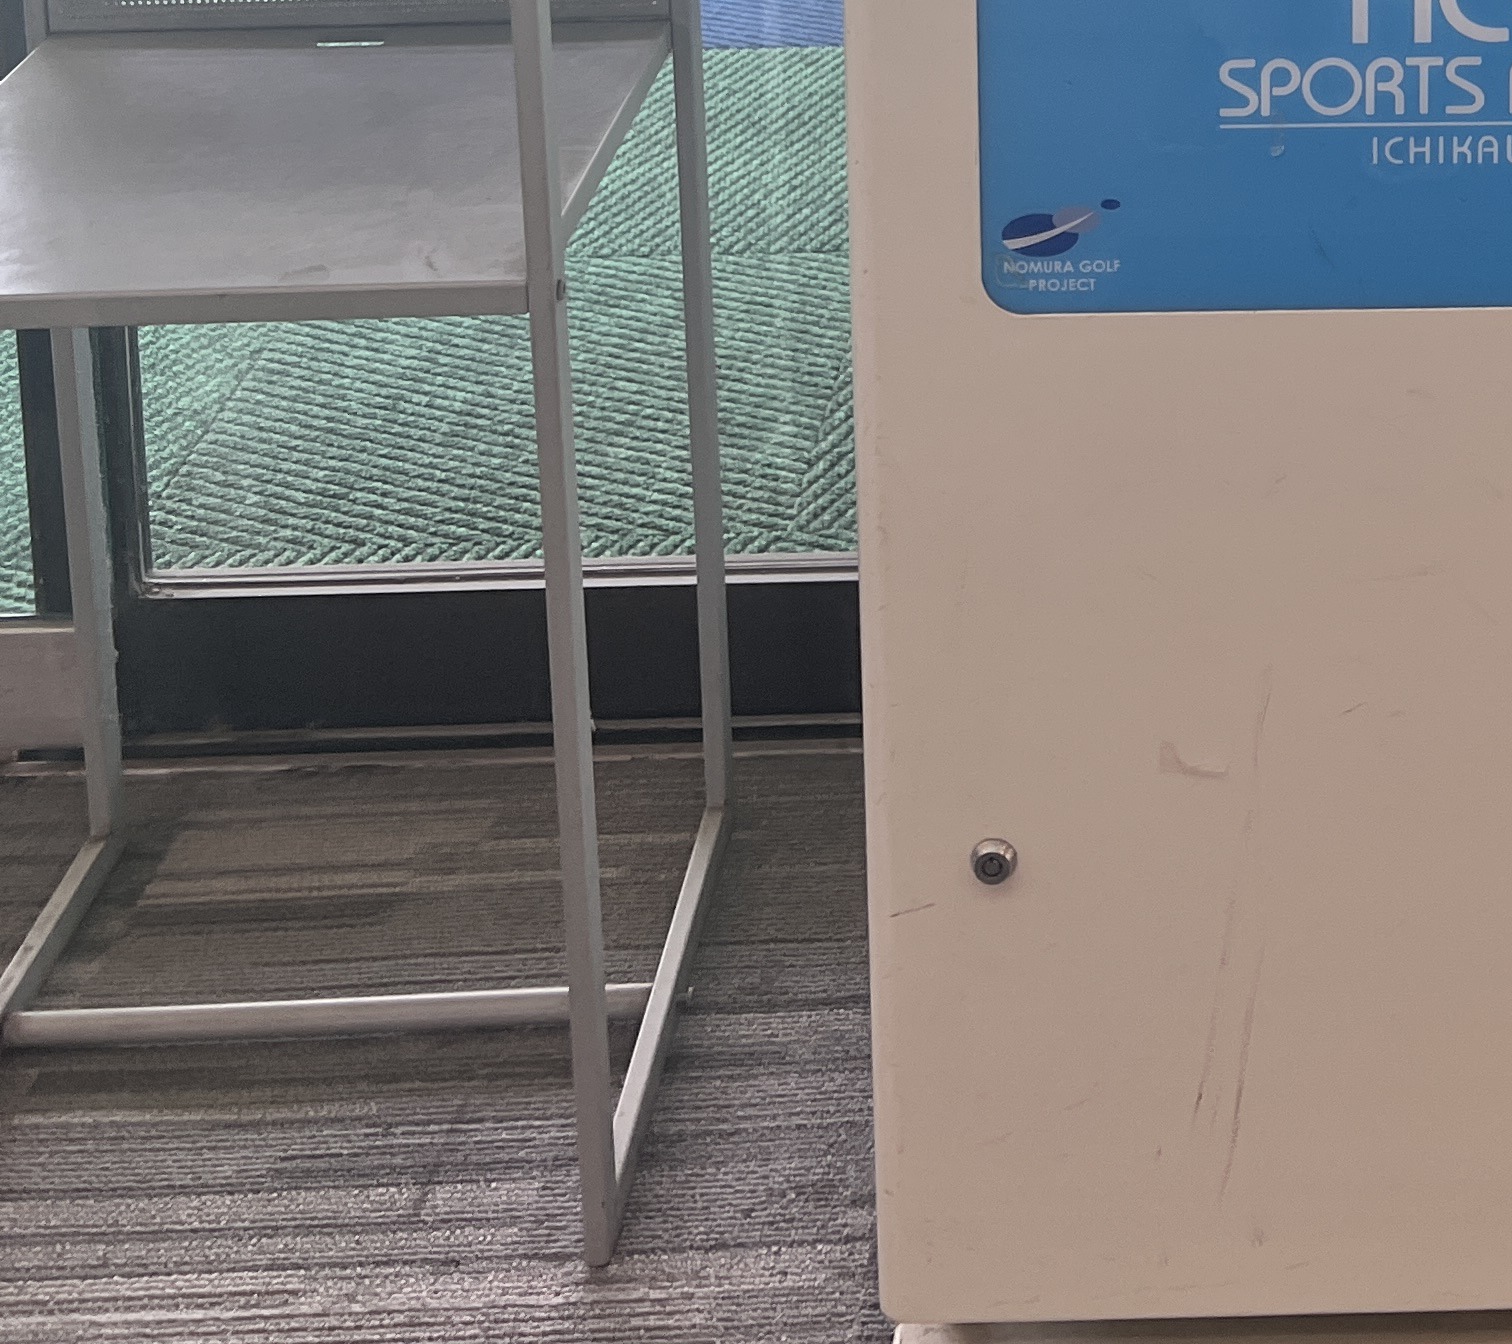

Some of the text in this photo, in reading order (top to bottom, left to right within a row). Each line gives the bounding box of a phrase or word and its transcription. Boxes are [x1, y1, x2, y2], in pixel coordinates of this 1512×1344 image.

[1218, 55, 1486, 117] SPORTS
[1004, 260, 1120, 273] NOMURA GOLF
[1028, 279, 1096, 291] PROJECT
